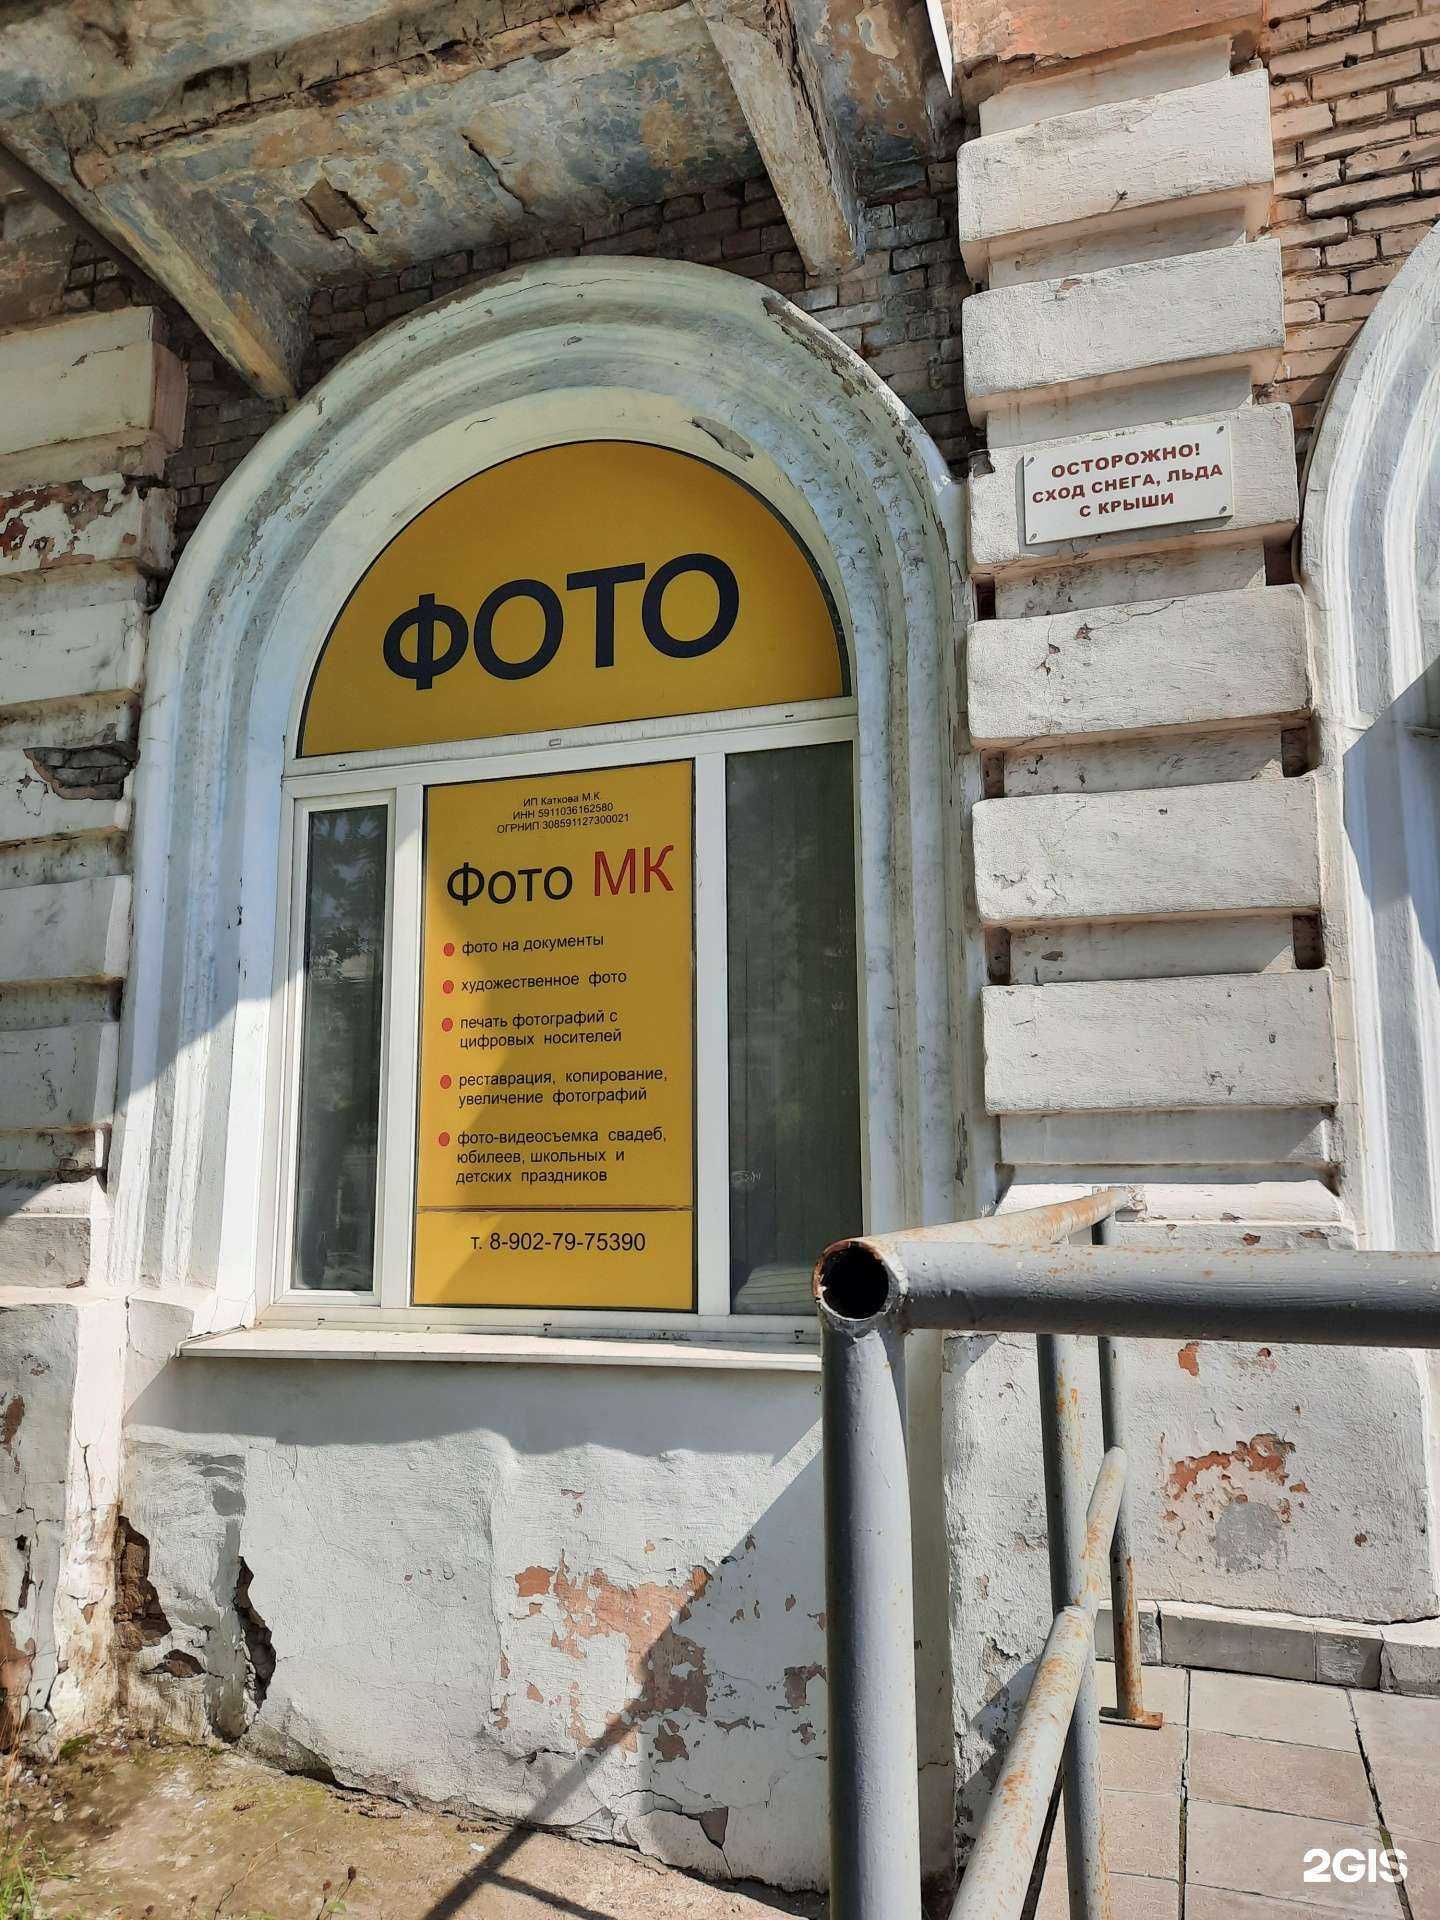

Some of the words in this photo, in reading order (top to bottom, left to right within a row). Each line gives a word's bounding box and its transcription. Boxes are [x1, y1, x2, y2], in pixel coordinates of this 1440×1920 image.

[1051, 442, 1200, 478] ОСТОРОЖНО!
[1032, 484, 1085, 503] СХОД
[1091, 473, 1160, 494] СНЕГА,
[1167, 464, 1223, 483] ЛЬДА
[1080, 505, 1091, 517] С
[1098, 492, 1174, 514] КРЫШИ
[383, 552, 741, 691] ФОТО
[523, 797, 538, 807] ИП
[541, 794, 579, 806] Каткова
[512, 810, 535, 820] ИНН
[496, 821, 540, 834] ОГРНИП
[447, 862, 573, 906] Фото
[594, 844, 674, 896] МК
[462, 940, 497, 956] фото
[502, 940, 518, 952] на
[524, 934, 604, 952] документы
[462, 974, 579, 992] художественное
[588, 970, 627, 986] фото
[460, 1016, 508, 1029] печать
[512, 1010, 605, 1028] фотографий
[610, 1012, 618, 1022] с
[460, 1033, 534, 1049] цифровых
[544, 1028, 622, 1044] носителей
[459, 1072, 556, 1088] реставрация,
[566, 1068, 668, 1084] копирование,
[458, 1091, 544, 1108] увеличение
[552, 1089, 647, 1104] фотографий
[458, 1131, 598, 1146] фото-видеосъемка
[608, 1127, 666, 1142] свадеб,
[457, 1150, 525, 1164] юбилеев,
[530, 1150, 606, 1162] школьных
[616, 1150, 624, 1161] и
[456, 1170, 512, 1185] детских
[522, 1170, 608, 1184] праздников
[470, 1236, 482, 1250] т.
[490, 1232, 646, 1251] 8-902-79-75390
